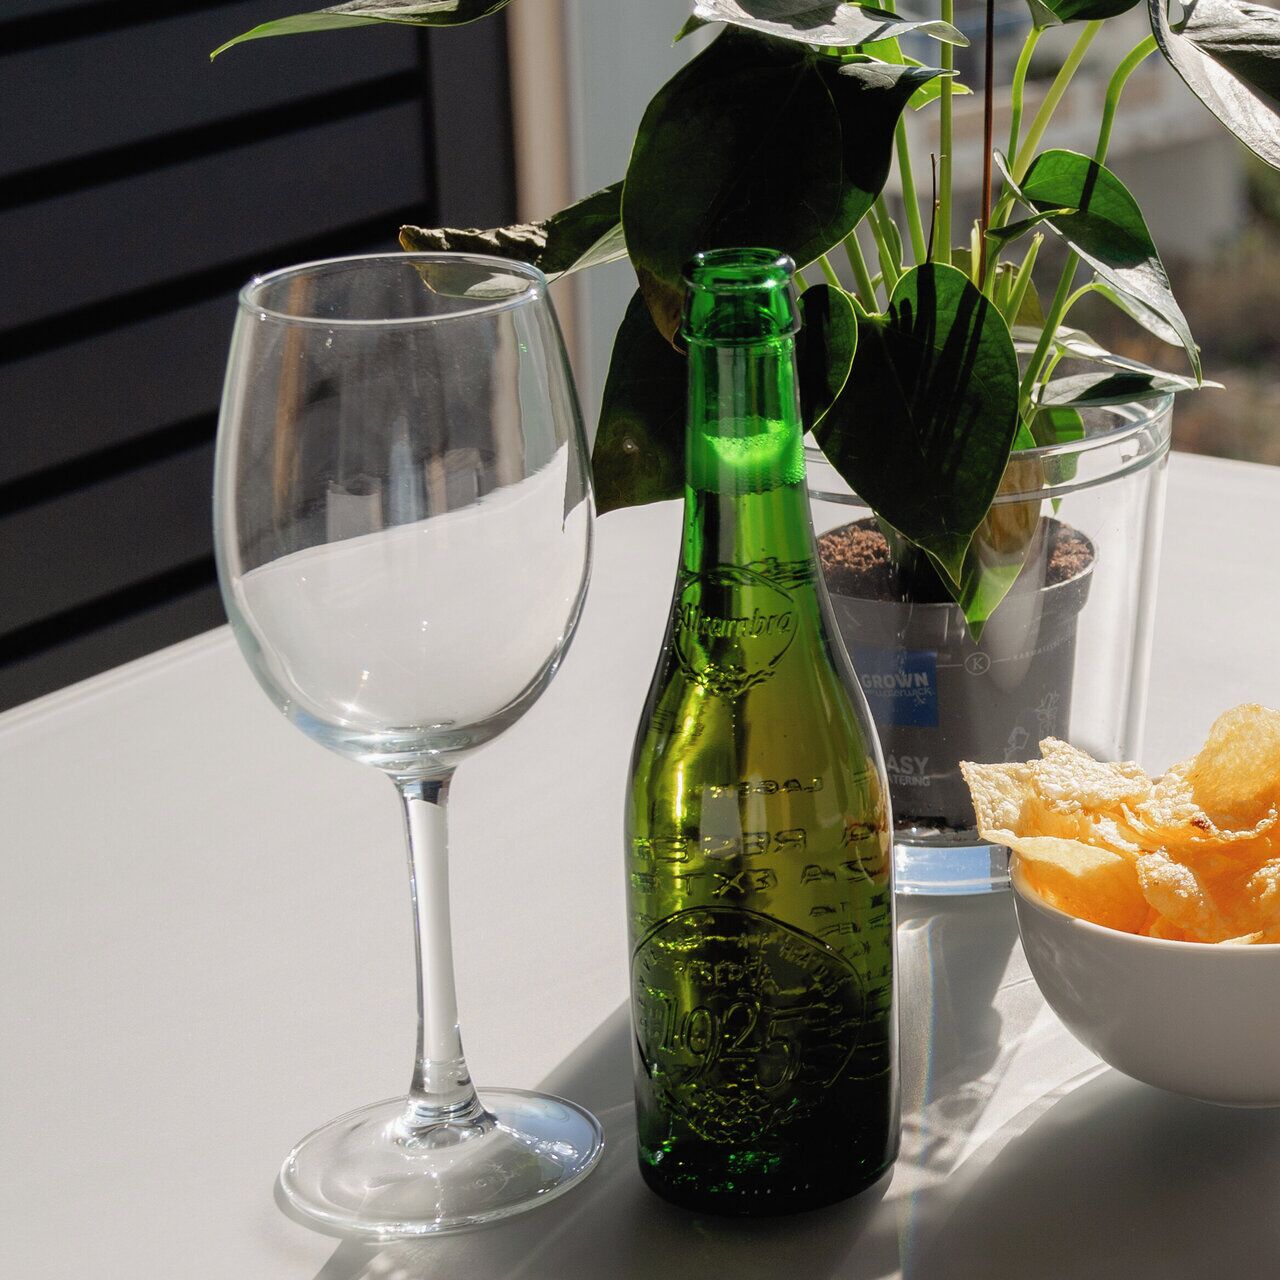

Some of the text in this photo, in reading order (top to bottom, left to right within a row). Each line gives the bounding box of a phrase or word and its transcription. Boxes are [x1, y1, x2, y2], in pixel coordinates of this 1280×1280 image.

[676, 602, 793, 638] Alhambra
[861, 671, 930, 690] GROWN
[886, 754, 930, 775] ASY
[888, 775, 931, 787] TERING
[659, 996, 803, 1092] 1925
